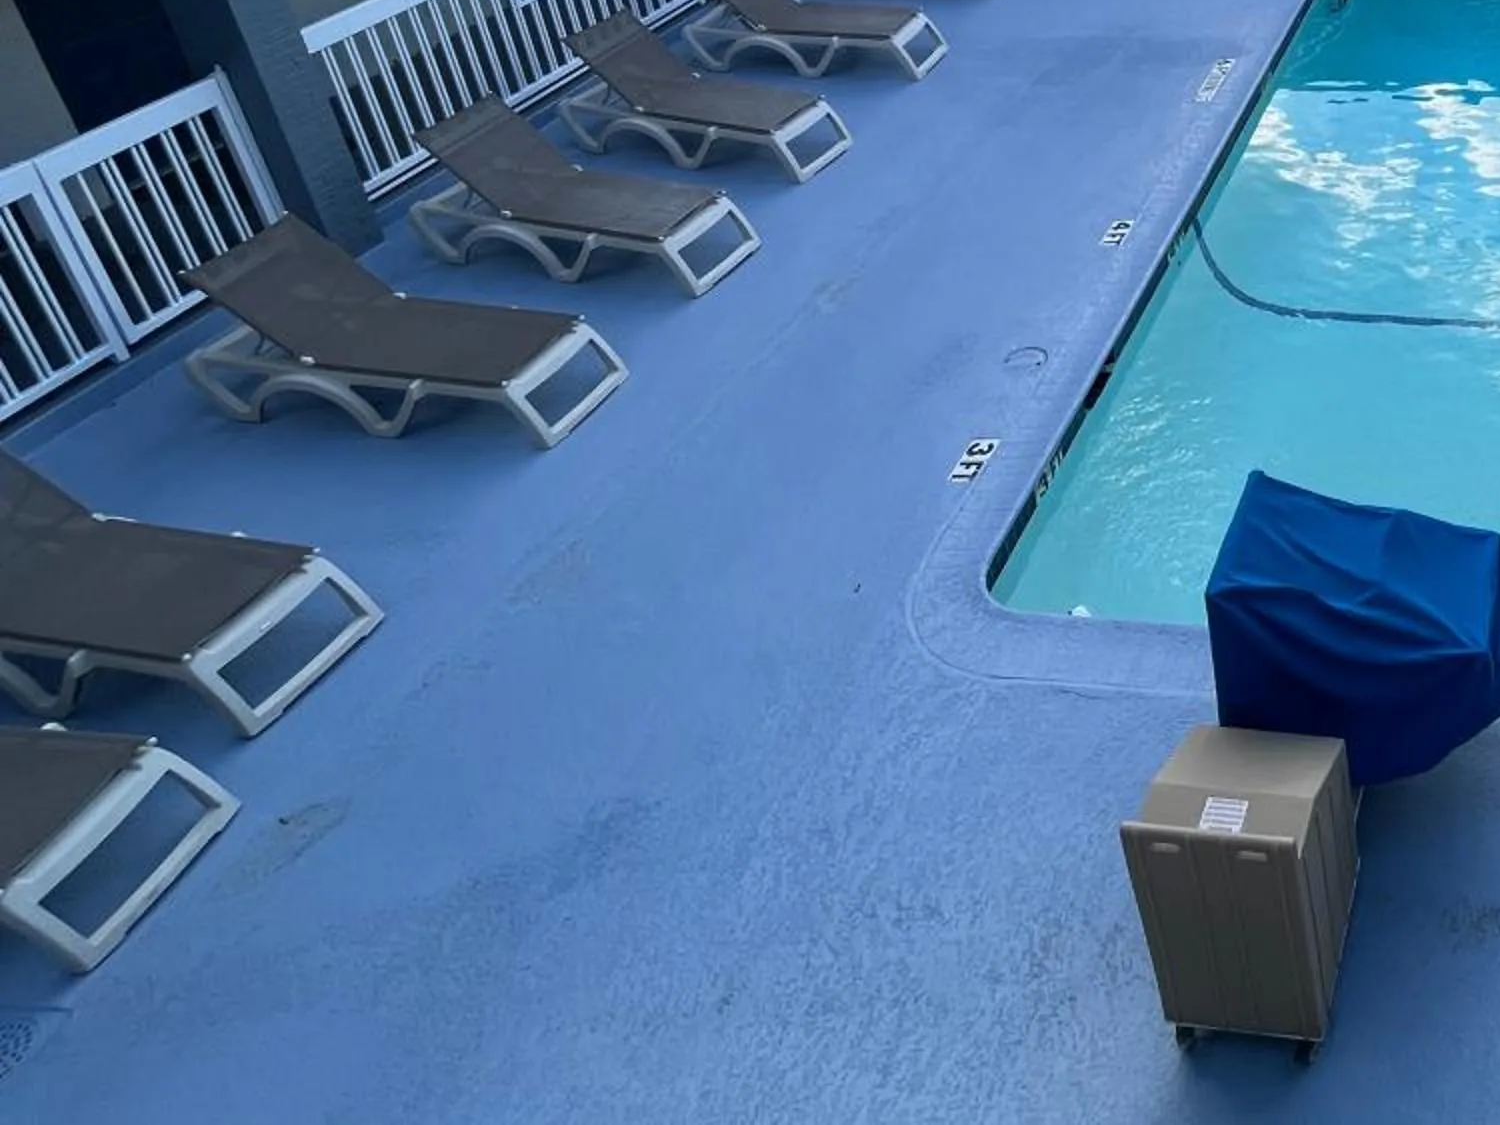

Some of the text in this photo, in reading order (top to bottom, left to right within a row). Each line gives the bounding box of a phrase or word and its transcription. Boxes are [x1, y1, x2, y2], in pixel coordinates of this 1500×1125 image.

[1111, 222, 1131, 231] 4
[951, 442, 994, 481] 3 FT
